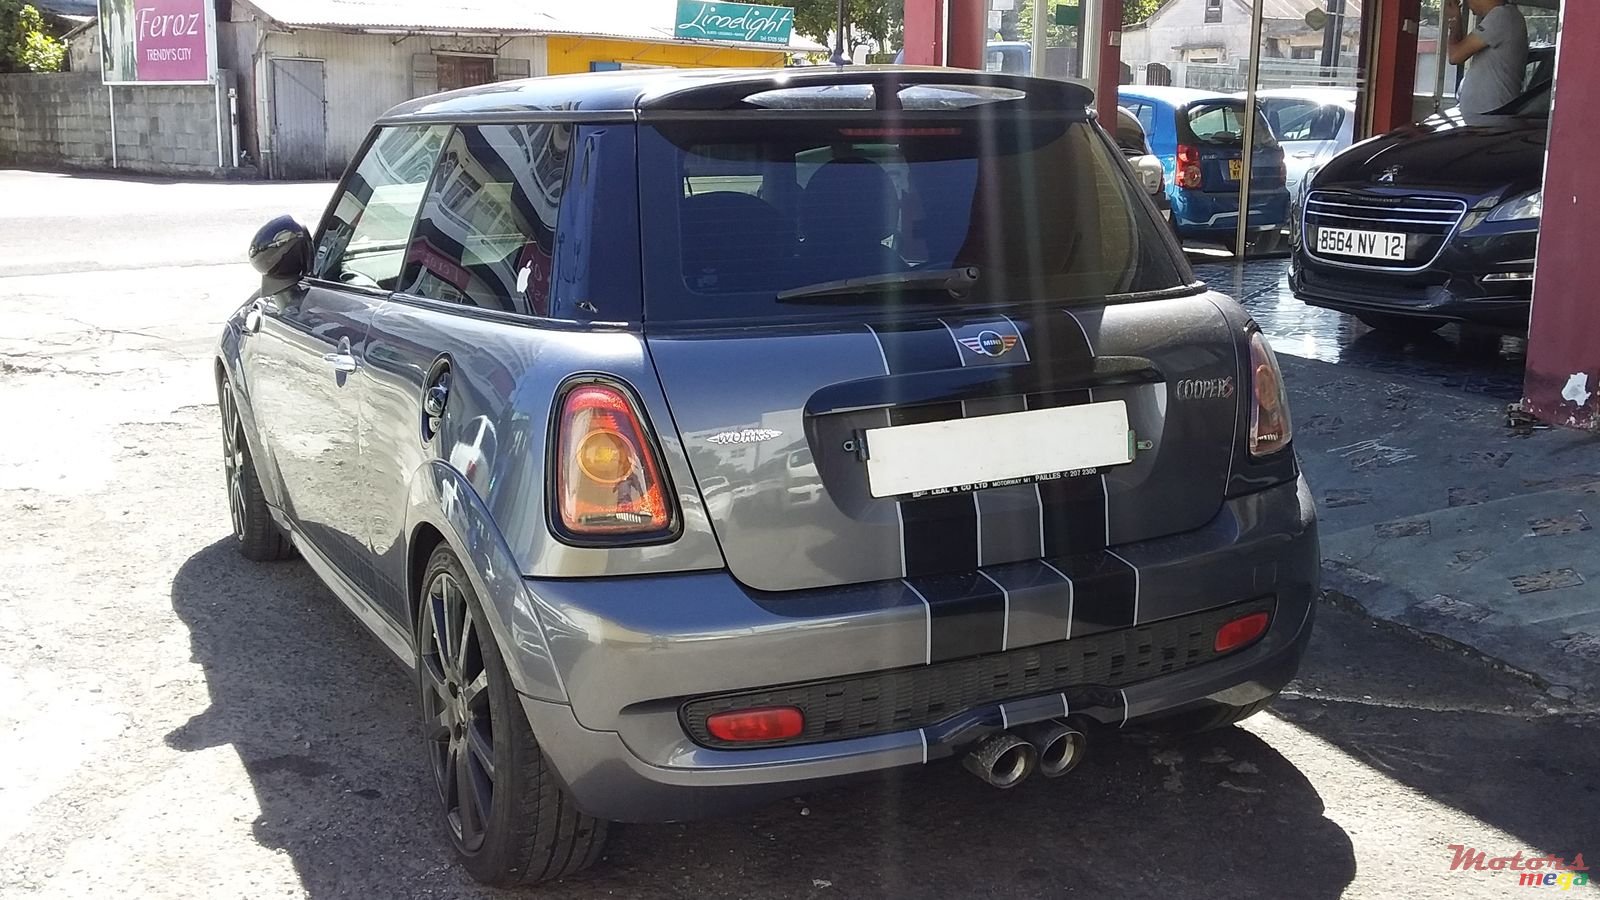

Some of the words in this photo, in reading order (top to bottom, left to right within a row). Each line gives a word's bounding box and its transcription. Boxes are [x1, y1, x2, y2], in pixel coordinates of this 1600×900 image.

[136, 8, 199, 41] Feroz
[678, 3, 791, 40] Limelight
[147, 48, 176, 61] TRENDY'S
[177, 48, 192, 60] CITY
[1321, 230, 1353, 253] 8564
[1358, 233, 1376, 254] NV
[1384, 235, 1401, 257] 12
[983, 339, 1002, 347] MINI
[717, 428, 772, 444] WORKS
[931, 486, 950, 496] LEAL
[974, 482, 988, 490] LTD
[992, 478, 1022, 487] MOTORWAY
[1035, 472, 1061, 482] PAILLES
